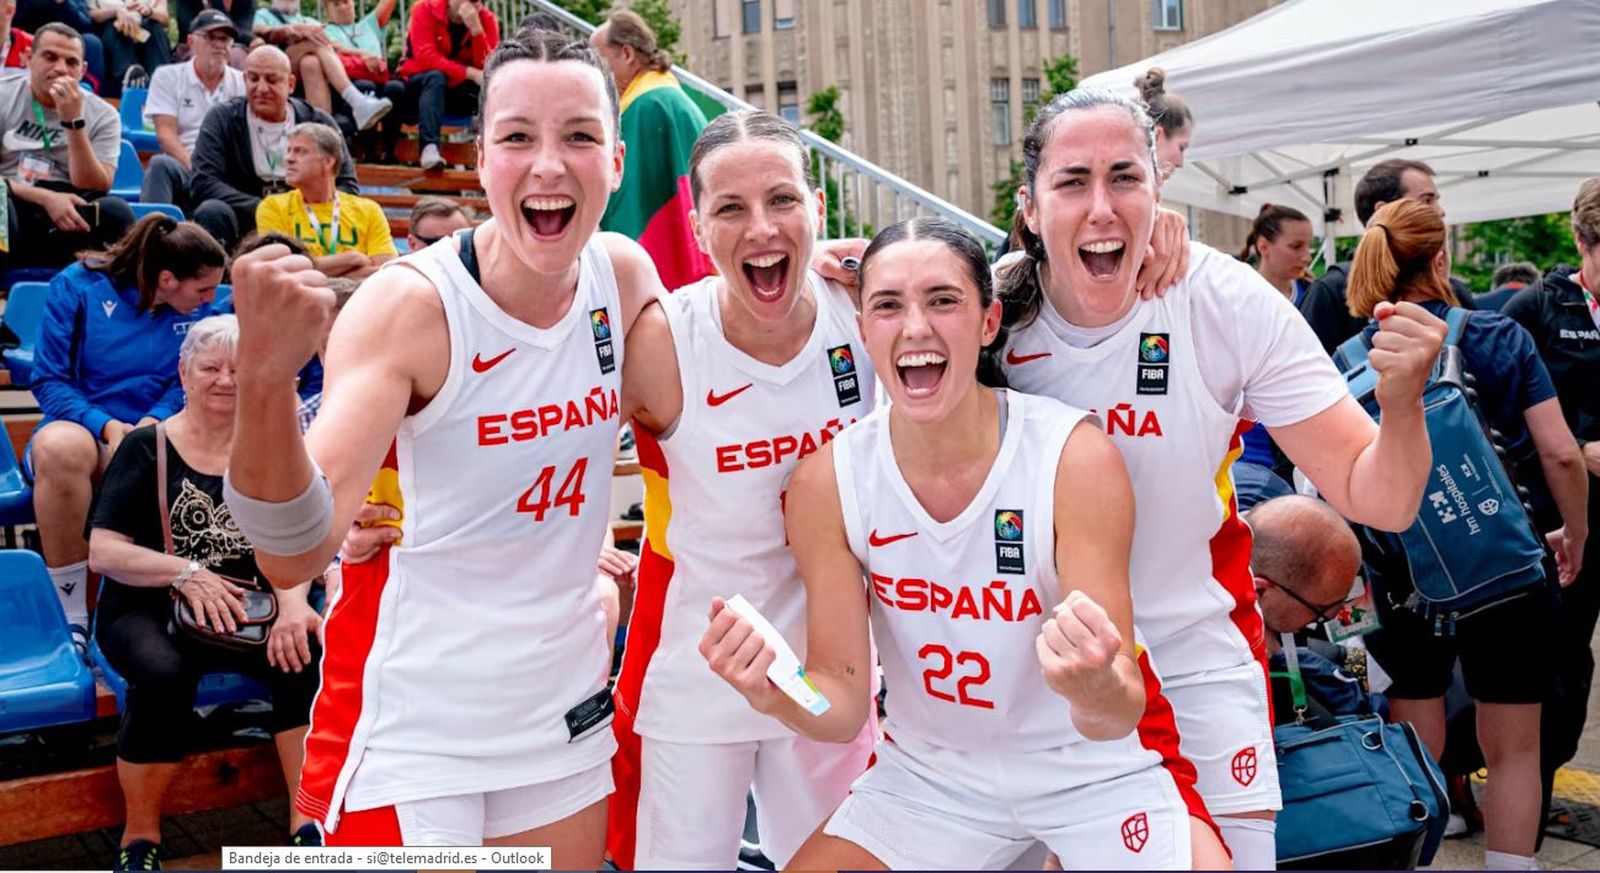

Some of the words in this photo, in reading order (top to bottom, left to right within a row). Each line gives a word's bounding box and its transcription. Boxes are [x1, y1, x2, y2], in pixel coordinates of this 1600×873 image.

[16, 119, 64, 142] NIKE
[838, 377, 856, 392] FIBA
[1141, 368, 1164, 380] FIBA
[477, 386, 619, 446] ESPAÑA
[716, 417, 857, 473] ESPAÑ
[516, 457, 588, 522] 44
[1436, 463, 1472, 517] hospitales
[1466, 515, 1482, 536] hm
[1000, 546, 1020, 559] FIBA
[870, 571, 1043, 622] ESPAÑA
[918, 644, 995, 709] 22
